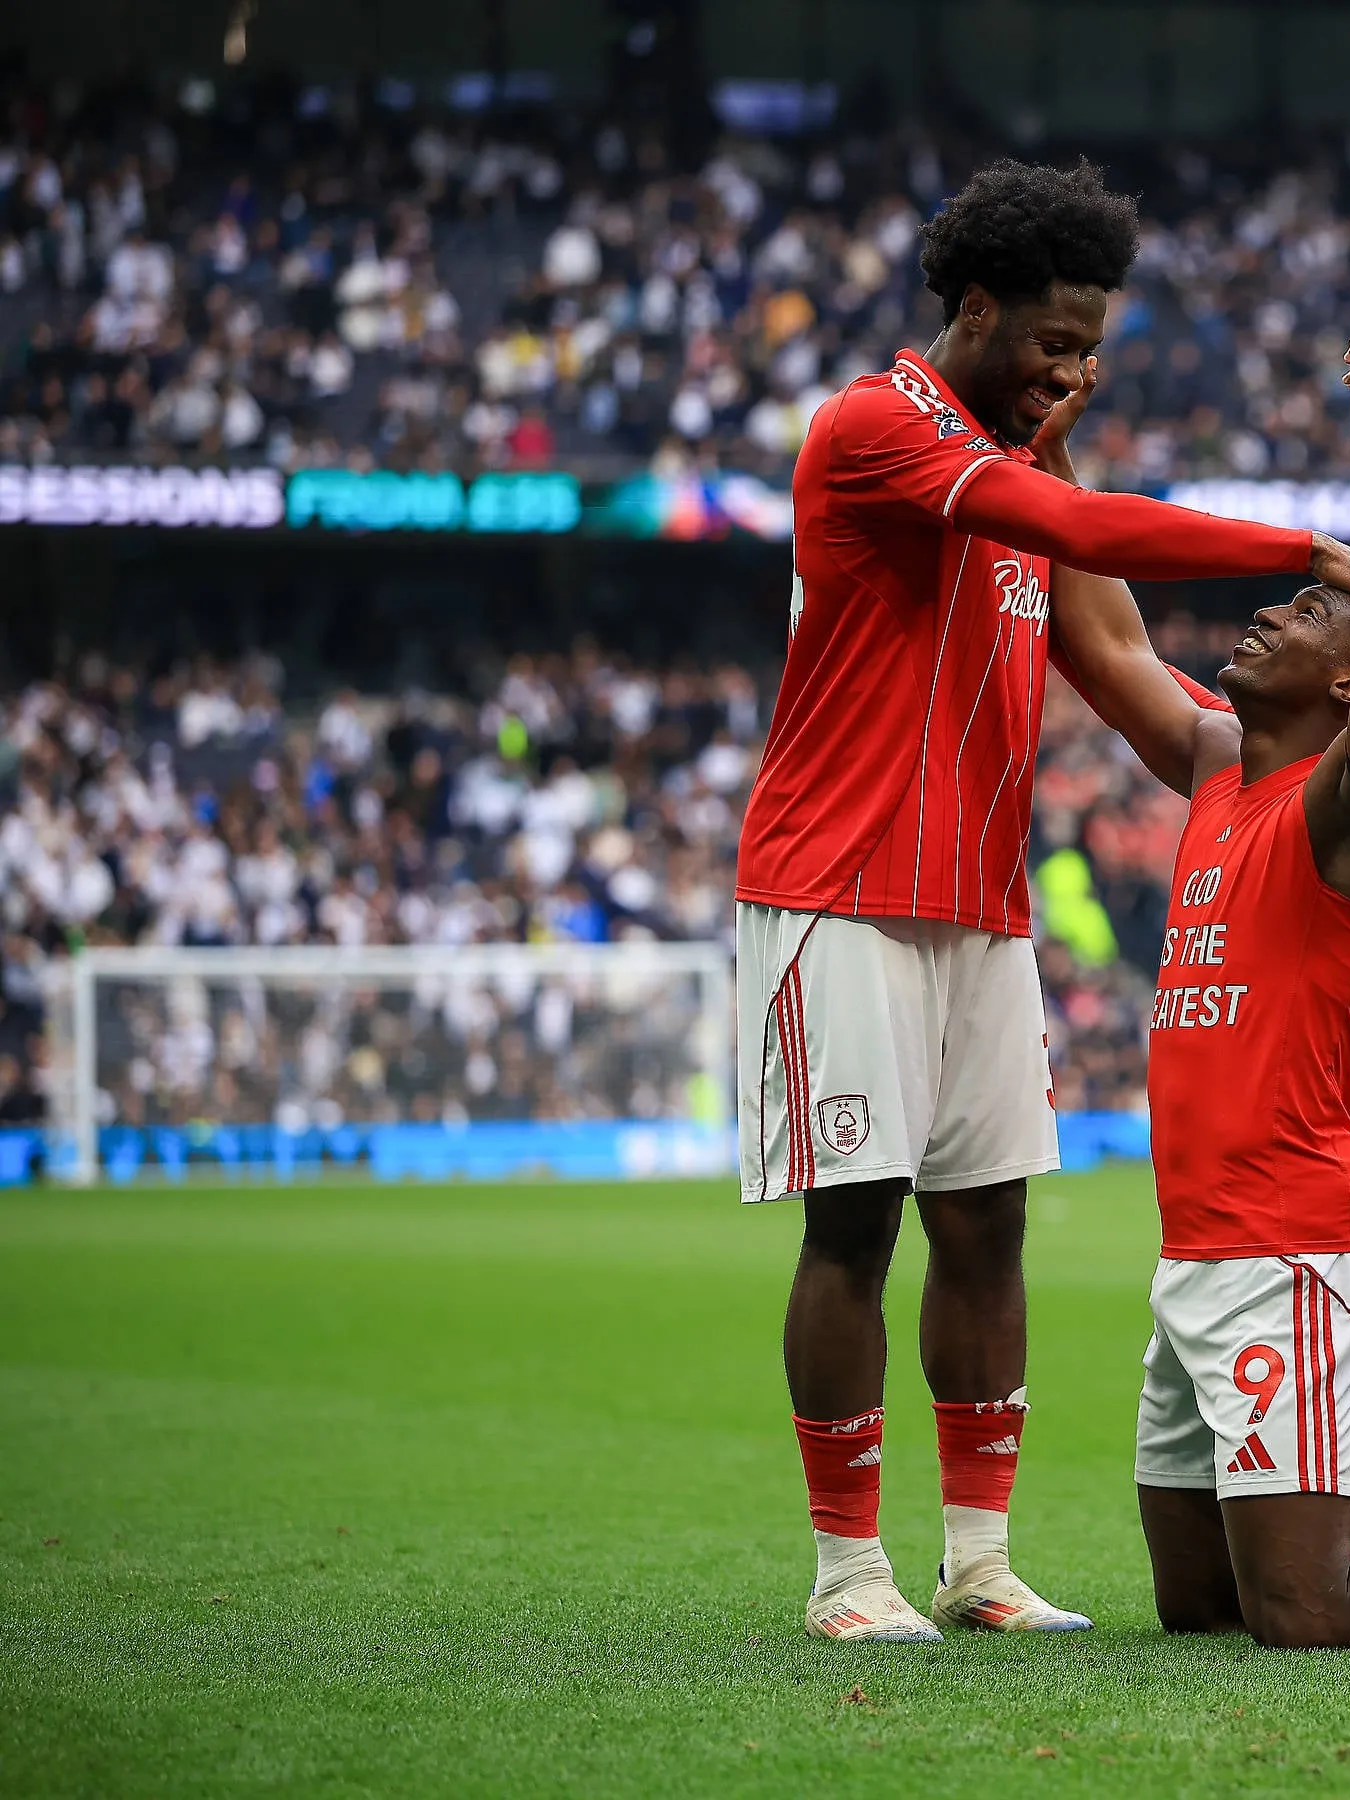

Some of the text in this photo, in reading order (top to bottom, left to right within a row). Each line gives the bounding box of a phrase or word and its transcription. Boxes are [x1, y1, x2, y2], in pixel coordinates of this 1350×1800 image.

[1182, 865, 1222, 907] GOD
[1180, 924, 1228, 966] THE
[1233, 1344, 1286, 1425] 9
